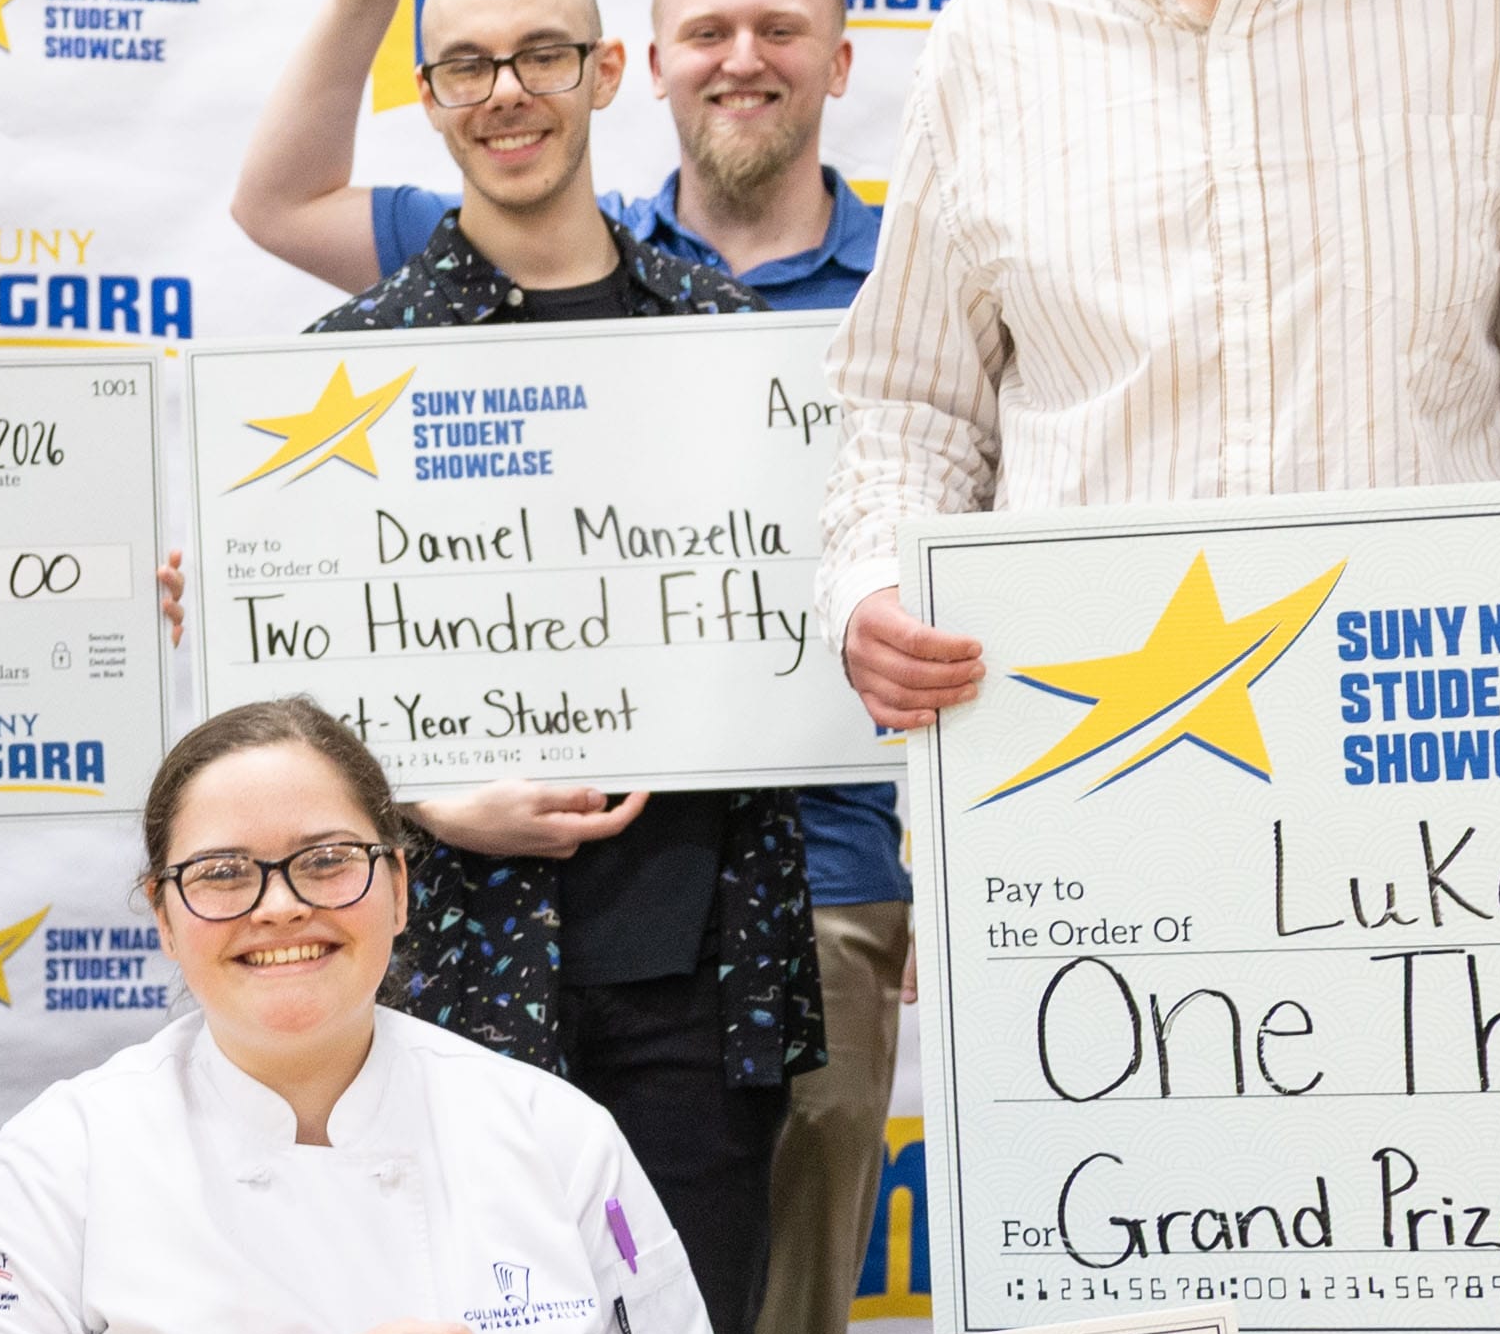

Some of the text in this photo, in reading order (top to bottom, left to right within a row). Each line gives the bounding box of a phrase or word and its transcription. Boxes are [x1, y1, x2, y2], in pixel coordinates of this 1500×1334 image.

[45, 6, 143, 31] STUDENT
[45, 36, 166, 62] SHOWCASE
[91, 380, 137, 396] 1001
[412, 386, 587, 417] SUNY NIAGARA
[413, 420, 525, 448] STUDENT
[416, 451, 553, 480] SHOWCASE
[376, 505, 791, 564] Daniel Manzella
[234, 568, 807, 677] Two Hundred Fifty
[1337, 608, 1467, 661] SUNY
[484, 687, 638, 740] Student
[986, 876, 1085, 909] Pay to
[46, 929, 102, 951] SUNY
[988, 916, 1192, 948] the Order Of
[46, 957, 146, 981] STUDENT
[45, 986, 168, 1011] SHOWCASE
[1036, 955, 1323, 1103] One
[1059, 1152, 1332, 1268] Grand
[1002, 1219, 1057, 1248] For
